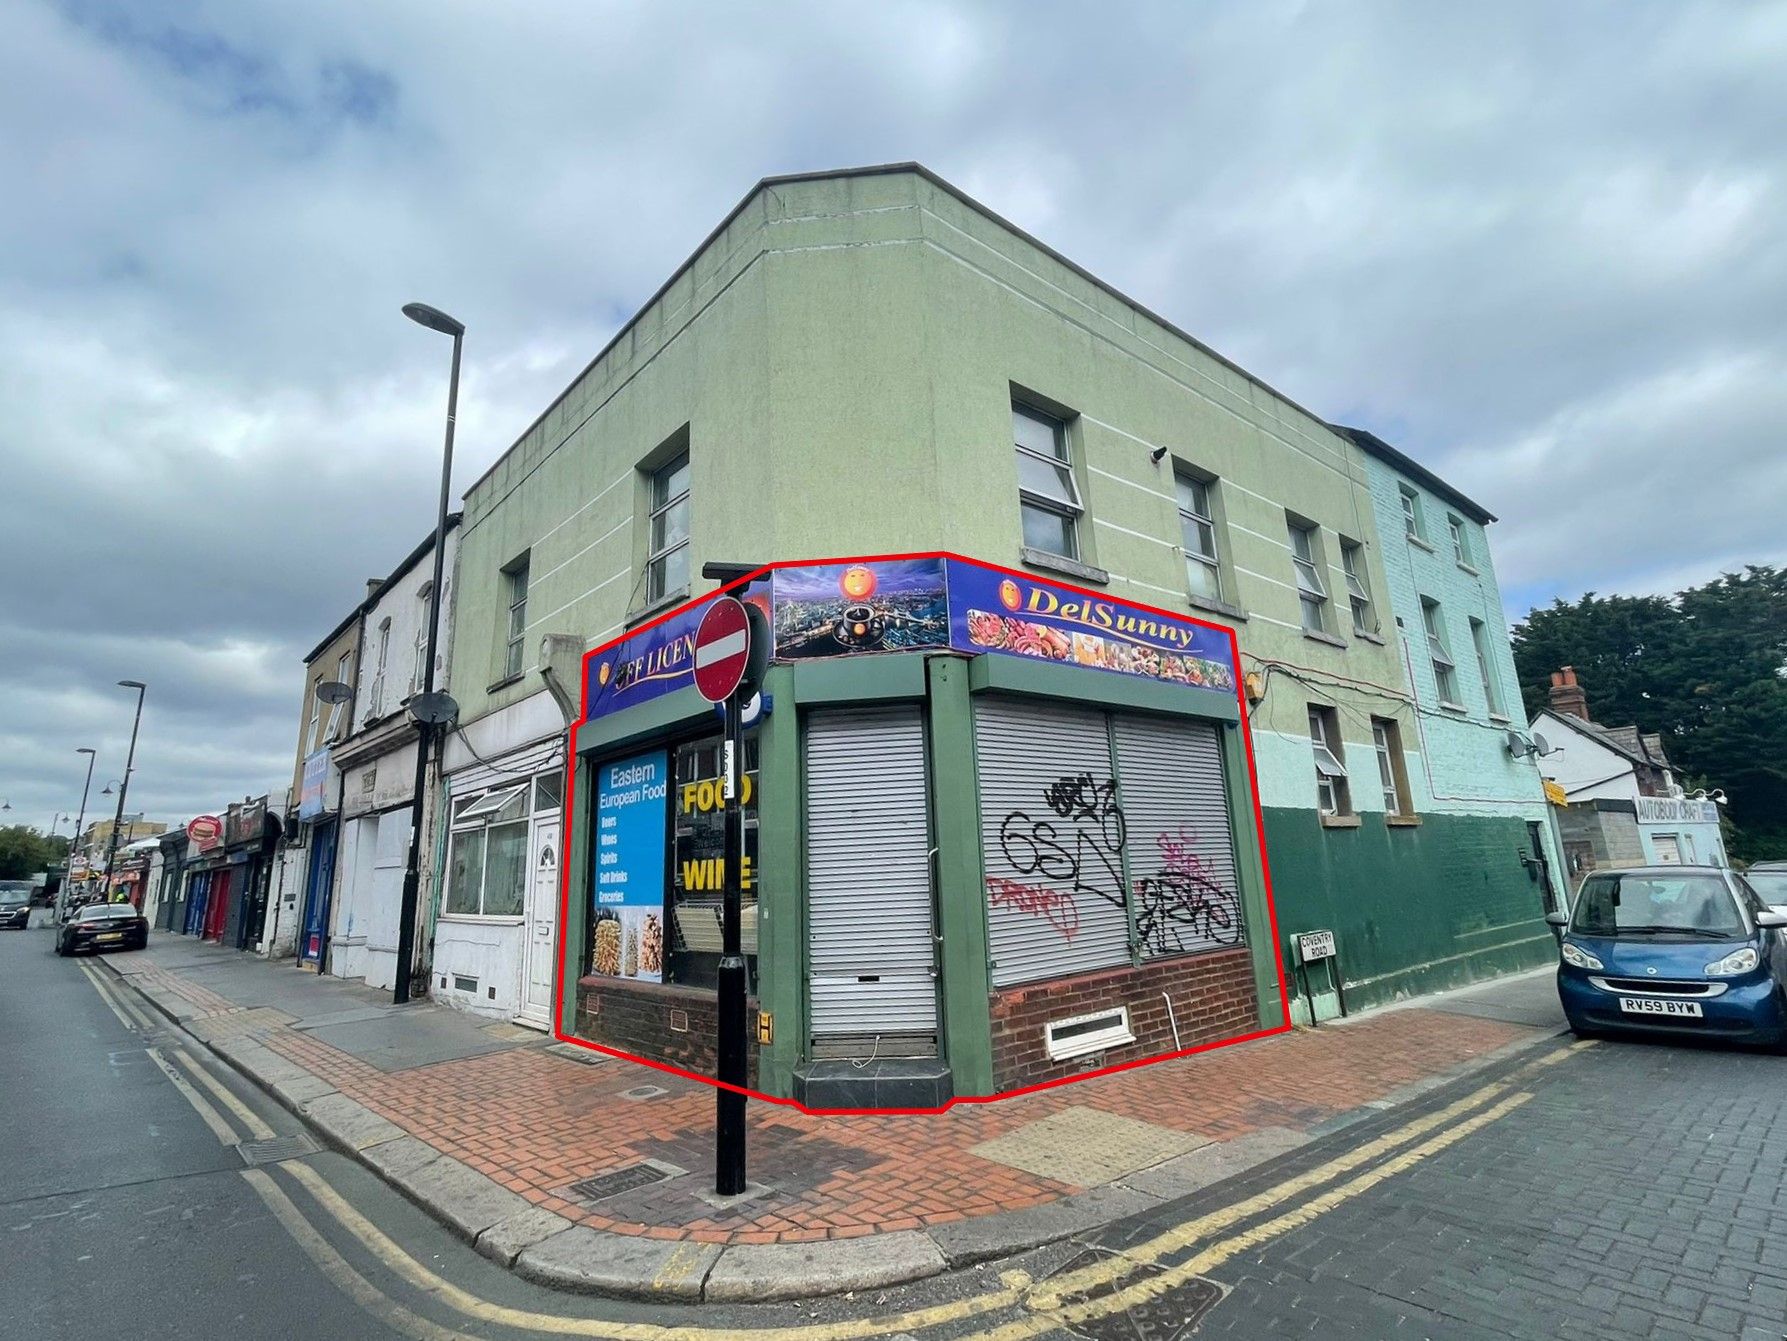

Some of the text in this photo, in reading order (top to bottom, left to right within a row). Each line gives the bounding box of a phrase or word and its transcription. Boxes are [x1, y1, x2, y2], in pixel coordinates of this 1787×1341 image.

[1026, 586, 1194, 648] DelSunny
[647, 630, 695, 675] LICEN
[611, 764, 655, 789] Eastern
[600, 780, 667, 809] European Food
[599, 891, 624, 903] Groceries
[1302, 933, 1331, 947] COVENTRY
[1312, 945, 1327, 957] ROAD
[1626, 1000, 1695, 1014] RV59 BYW
